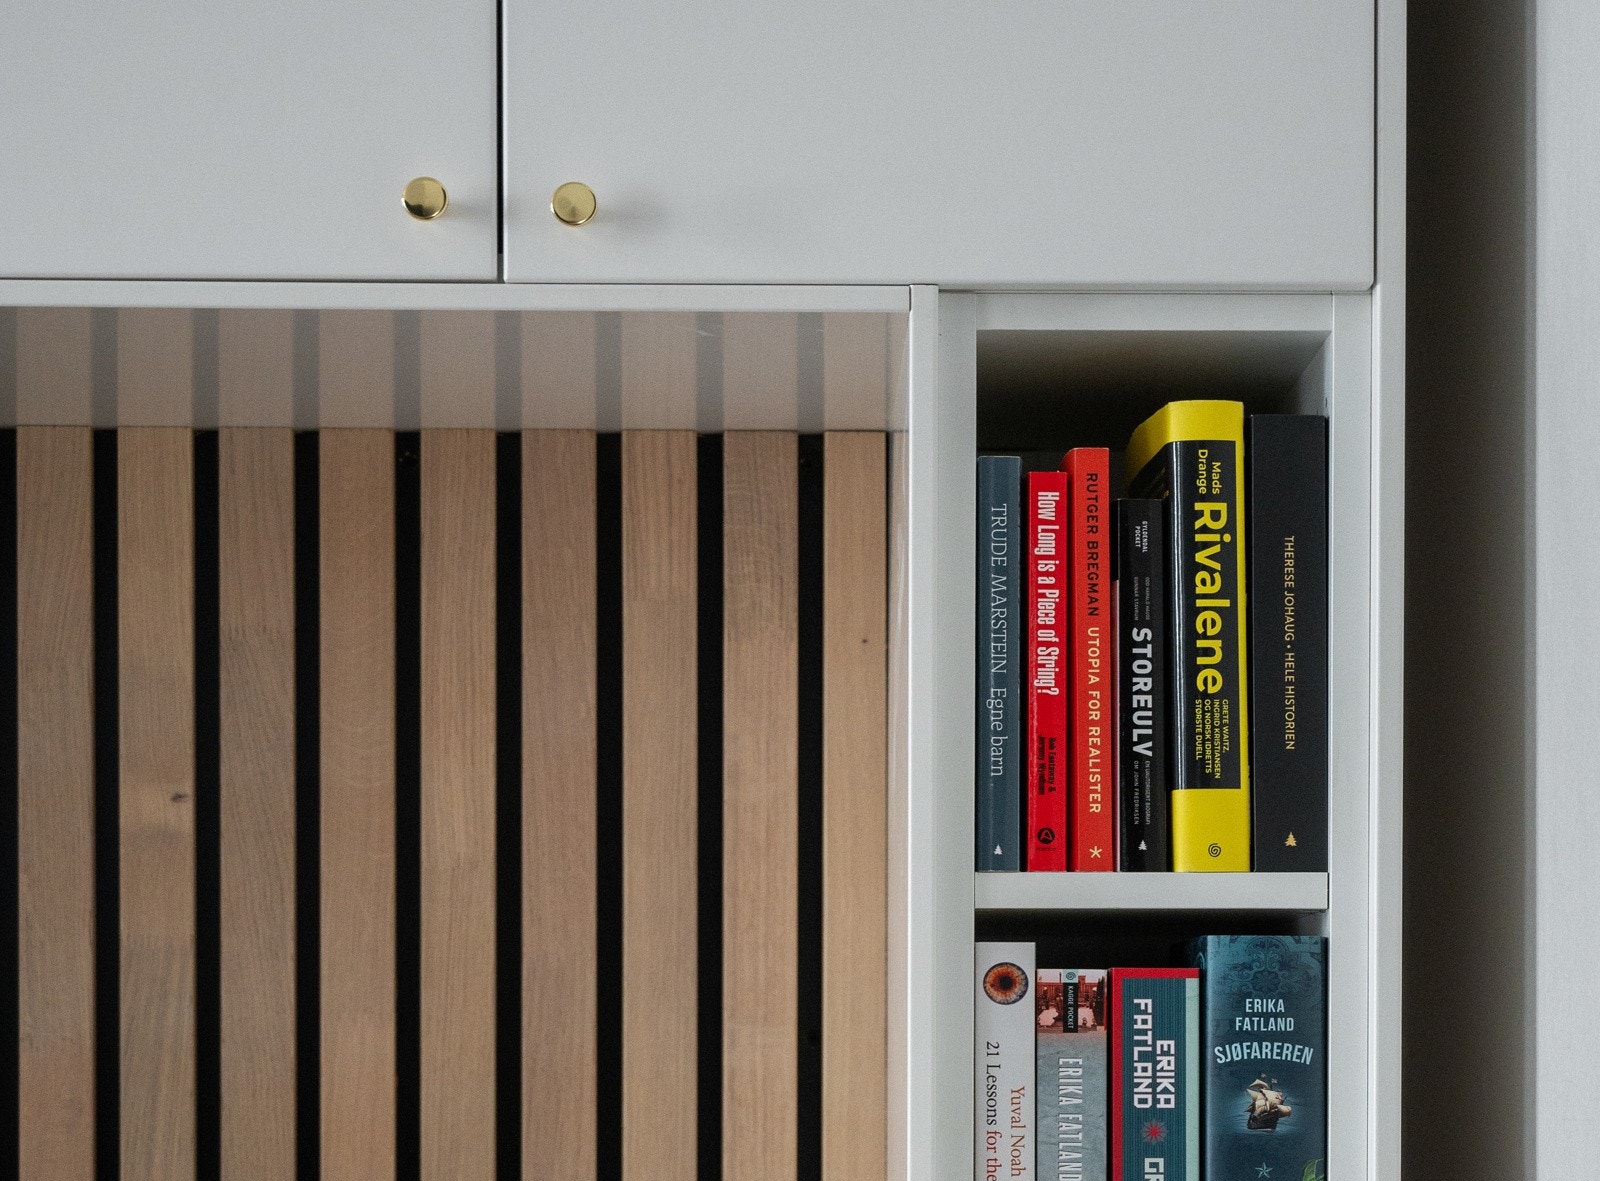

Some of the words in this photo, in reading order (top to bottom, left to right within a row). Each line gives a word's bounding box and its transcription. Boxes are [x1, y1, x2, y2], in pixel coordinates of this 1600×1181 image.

[1196, 449, 1208, 494] Drange
[1211, 462, 1222, 495] Mads
[1037, 491, 1060, 521] How
[1086, 473, 1098, 534] RUTGER
[990, 503, 1007, 567] TRUDE
[1034, 525, 1060, 556] Long
[1037, 560, 1060, 572] is
[1087, 540, 1099, 617] BREGMAN
[1284, 535, 1295, 588] THERESE
[1037, 589, 1060, 625] Piece
[1194, 502, 1231, 694] Rivalene
[1284, 589, 1295, 641] JOHAUG
[990, 573, 1008, 674] MARSTEIN
[1037, 629, 1060, 642] of
[1034, 646, 1060, 696] String?
[1087, 627, 1100, 685] UTOPIA
[1284, 652, 1295, 682] HELE
[986, 688, 1007, 731] Egne
[1088, 691, 1100, 720] FOR
[1131, 627, 1153, 757] STOREULV
[1204, 699, 1211, 711] OG
[1284, 686, 1295, 750] HISTORIEN
[990, 735, 1008, 776] barn
[1088, 726, 1102, 813] REALISTER
[1133, 761, 1139, 769] OM
[1235, 1017, 1295, 1031] FATLAND
[1245, 998, 1285, 1013] ERIKA
[986, 1041, 1000, 1057] 21
[1133, 998, 1152, 1109] FATLAND
[1214, 1041, 1314, 1065] SJØFAREREN
[986, 1064, 1001, 1126] Lessons
[1058, 1058, 1083, 1105] ERIKA
[1156, 1040, 1175, 1108] ERIKA
[1010, 1086, 1027, 1129] Yuval
[986, 1130, 1002, 1153] for
[1010, 1134, 1027, 1177] Noah
[1058, 1113, 1083, 1181] FATLAND
